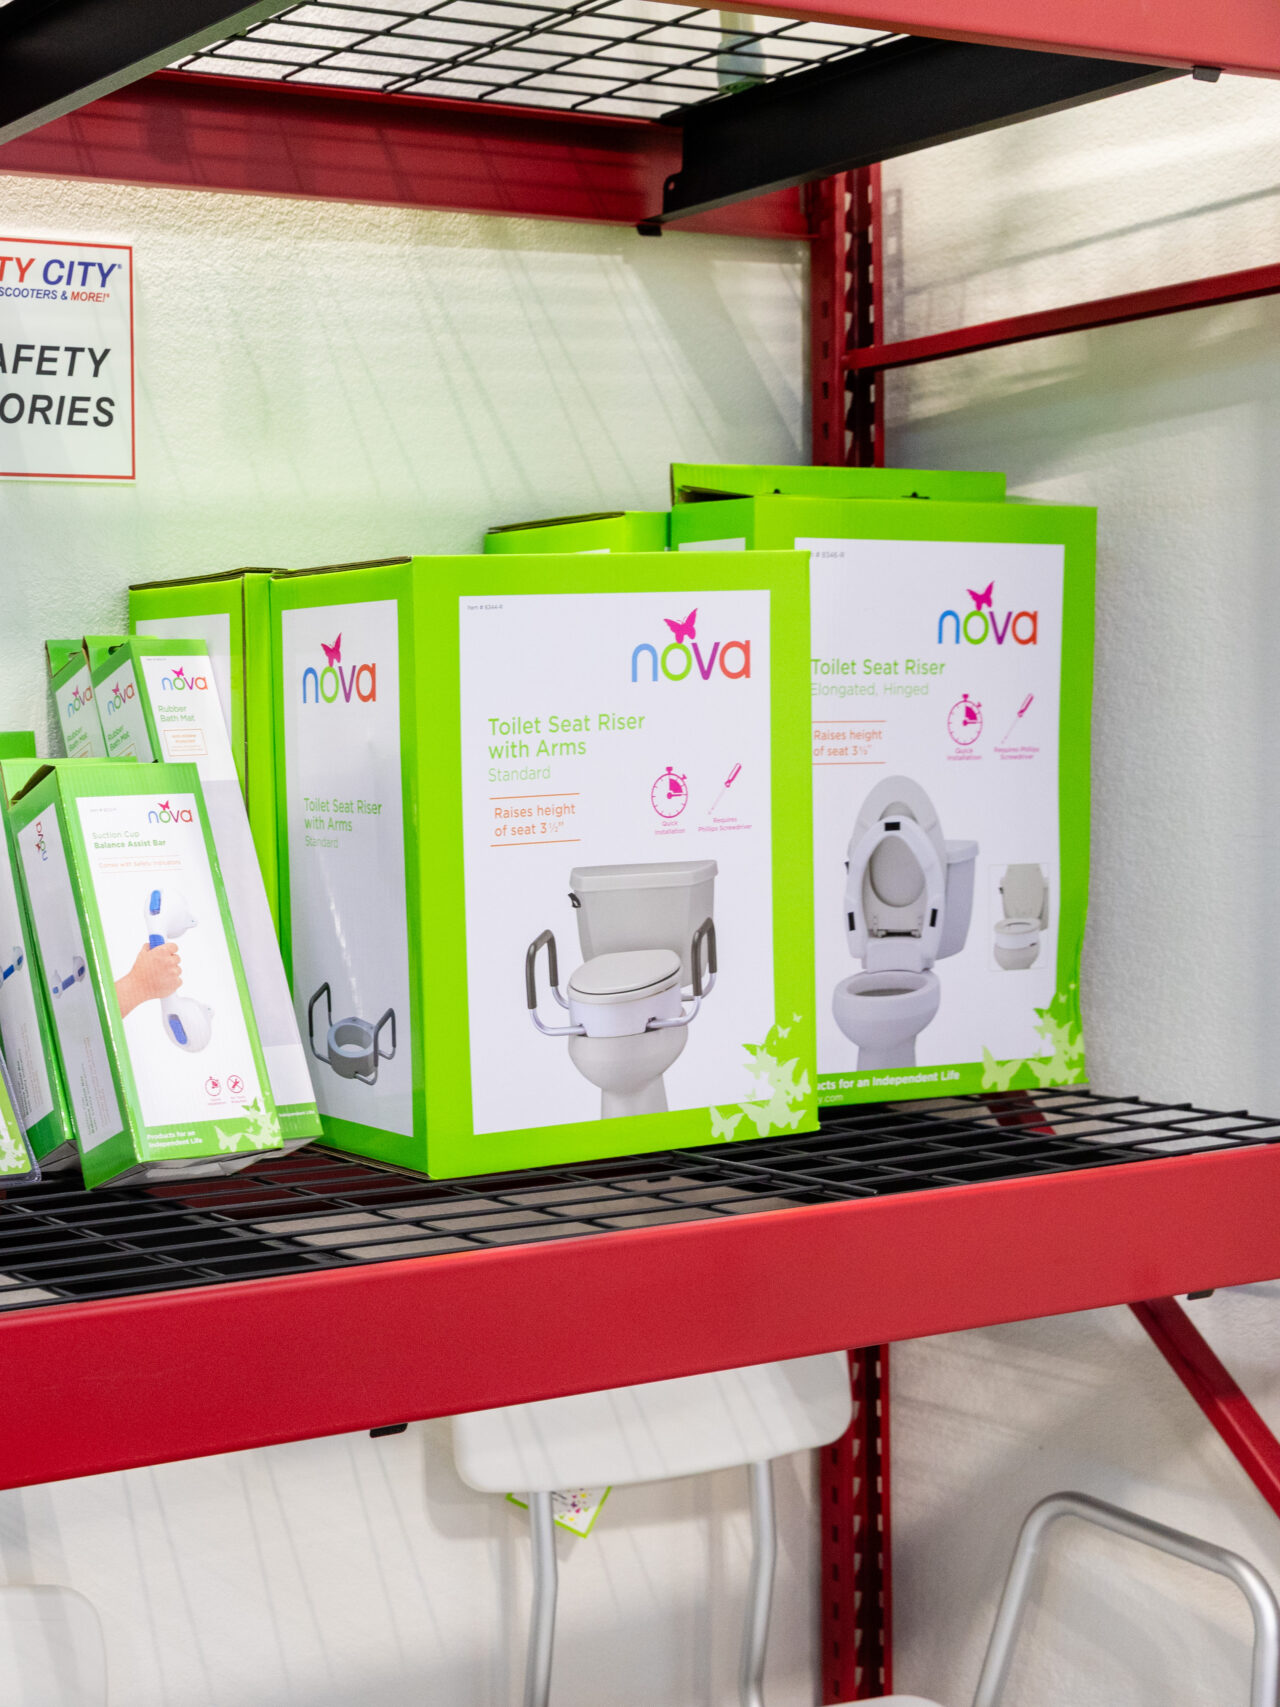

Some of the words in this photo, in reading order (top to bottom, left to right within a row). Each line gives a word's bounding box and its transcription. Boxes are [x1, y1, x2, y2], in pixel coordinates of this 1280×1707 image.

[60, 290, 68, 300] &
[937, 609, 1039, 645] nova
[631, 638, 752, 683] nova
[811, 658, 857, 675] Toilet
[862, 658, 899, 675] Seat
[904, 658, 946, 675] Riser
[161, 676, 209, 691] nova
[302, 662, 377, 704] nova
[811, 682, 879, 698] Elongated,
[883, 682, 929, 698] Hinged
[67, 685, 93, 718] nova
[107, 682, 135, 716] nova
[158, 704, 187, 713] Rubber
[160, 714, 178, 722] Bath
[180, 714, 196, 722] Mat
[488, 716, 542, 736] Toilet
[548, 715, 591, 733] Seat
[598, 712, 646, 731] Riser
[813, 729, 847, 741] Raises
[849, 729, 884, 742] height
[488, 740, 530, 759] with
[535, 739, 587, 758] Arms
[813, 745, 824, 756] of
[826, 745, 849, 756] seat
[488, 765, 551, 783] Standard
[304, 797, 330, 813] Toilet
[332, 798, 354, 814] Seat
[356, 799, 383, 815] Riser
[494, 806, 534, 819] Raises
[537, 803, 577, 818] height
[147, 809, 194, 824] nova
[304, 816, 325, 831] with
[327, 817, 353, 832] Arms
[91, 831, 122, 840] Suction
[124, 830, 141, 840] Cup
[494, 824, 507, 837] of
[511, 823, 536, 836] seat
[35, 821, 49, 861] nova
[94, 841, 126, 850] Balance
[127, 840, 151, 848] Assist
[304, 835, 339, 849] Standard
[838, 1078, 854, 1089] for
[856, 1079, 870, 1087] an
[872, 1072, 938, 1087] Independent
[940, 1070, 960, 1081] Life
